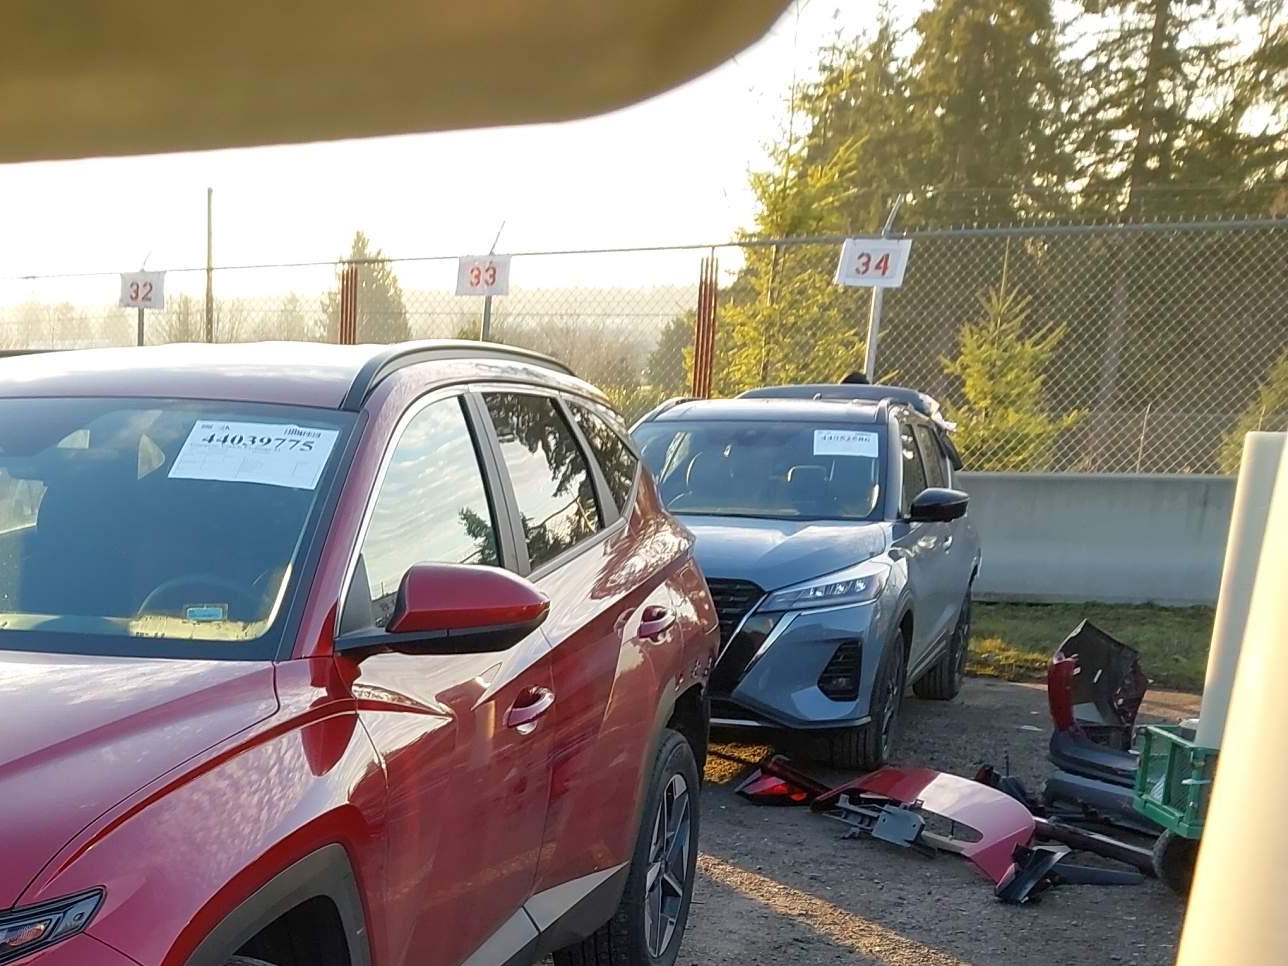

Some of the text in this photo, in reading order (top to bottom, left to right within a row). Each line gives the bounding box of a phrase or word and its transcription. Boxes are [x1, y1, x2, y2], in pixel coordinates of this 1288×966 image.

[469, 262, 498, 288] 33
[854, 252, 890, 277] 34
[128, 279, 154, 303] 32
[201, 432, 316, 452] 44039775
